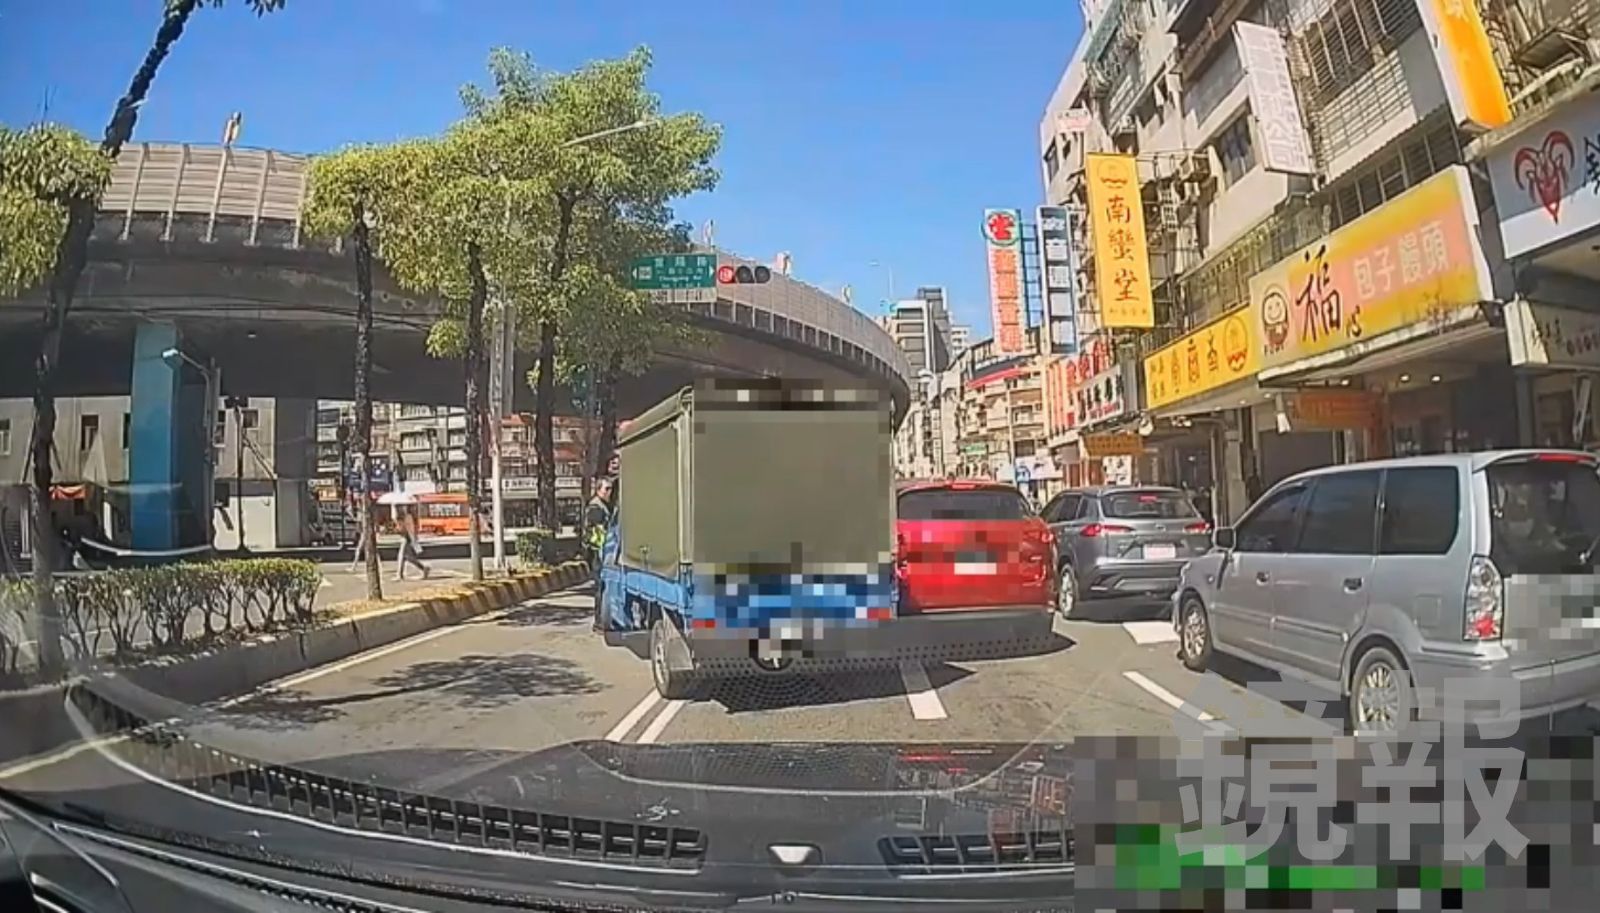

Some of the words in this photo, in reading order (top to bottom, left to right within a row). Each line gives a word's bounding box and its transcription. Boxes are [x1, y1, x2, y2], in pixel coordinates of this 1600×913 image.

[1106, 194, 1140, 302] 南蠻堂
[1353, 220, 1449, 300] 包子饅頭
